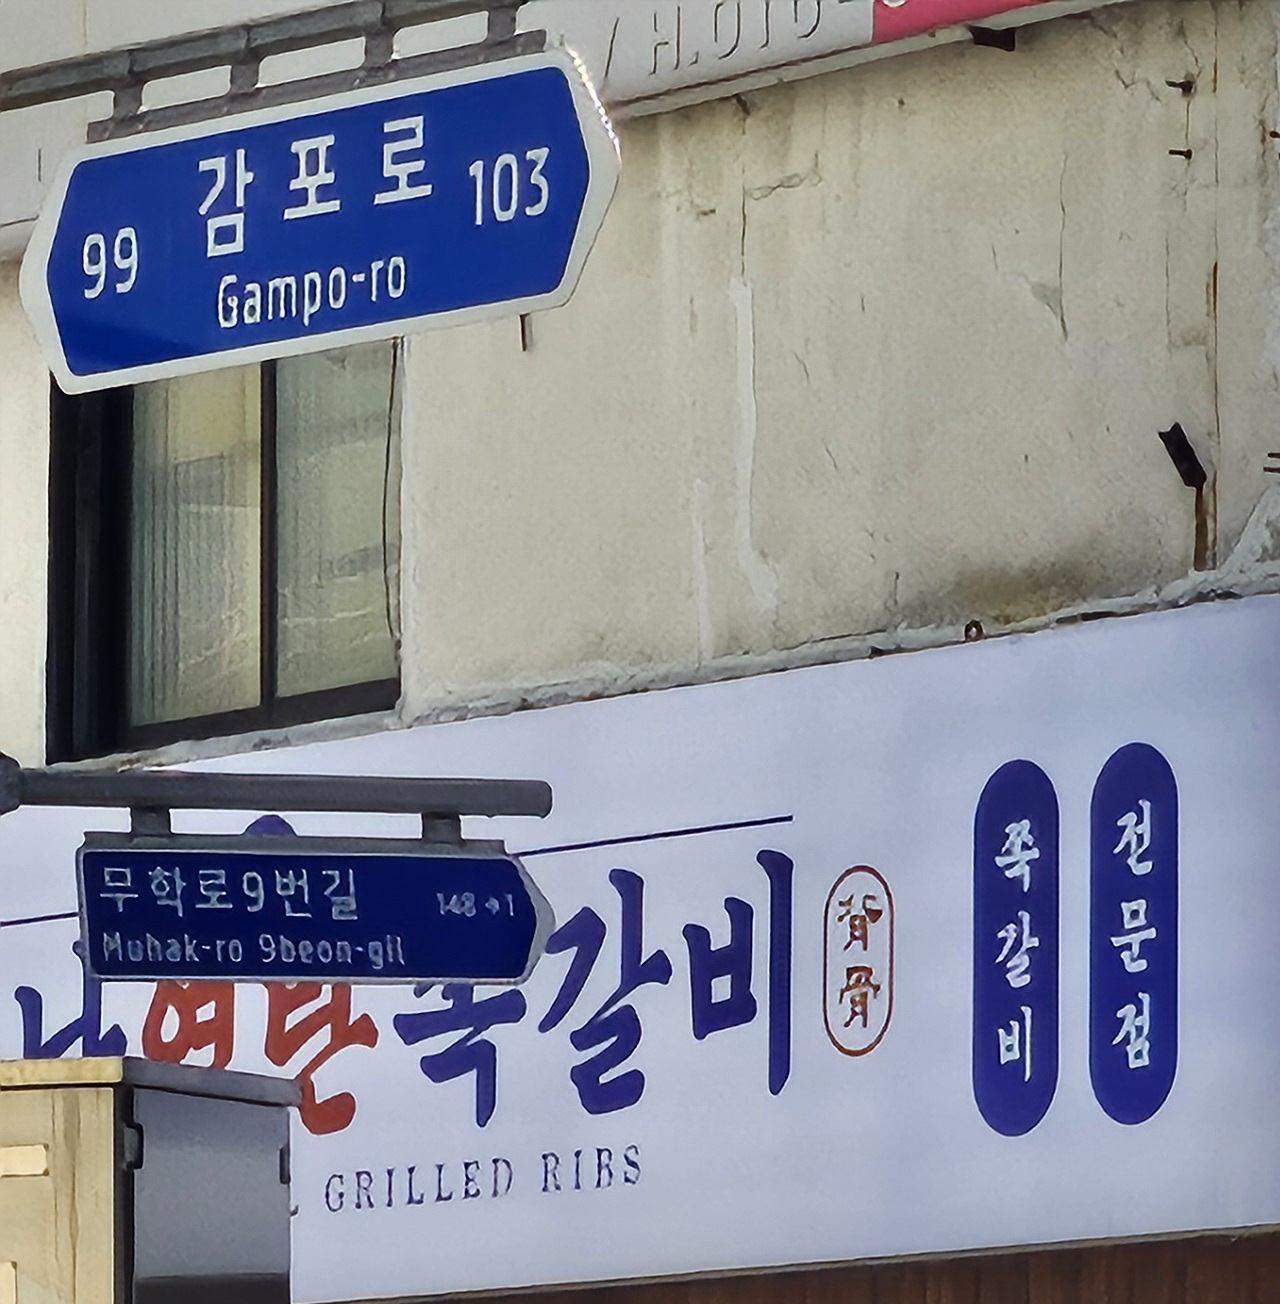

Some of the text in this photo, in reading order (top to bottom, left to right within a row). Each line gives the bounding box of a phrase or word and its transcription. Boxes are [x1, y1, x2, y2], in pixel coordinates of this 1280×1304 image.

[82, 115, 550, 299] 99 감포로 103
[217, 255, 406, 329] Gampo-ro
[100, 867, 358, 920] 무학로9번길
[103, 931, 405, 969] Muhak-ro 9beon-gil
[993, 819, 1041, 1083] 쪽갈비
[1110, 798, 1157, 1070] 전문점
[325, 1145, 642, 1213] GRILLED RIBS
